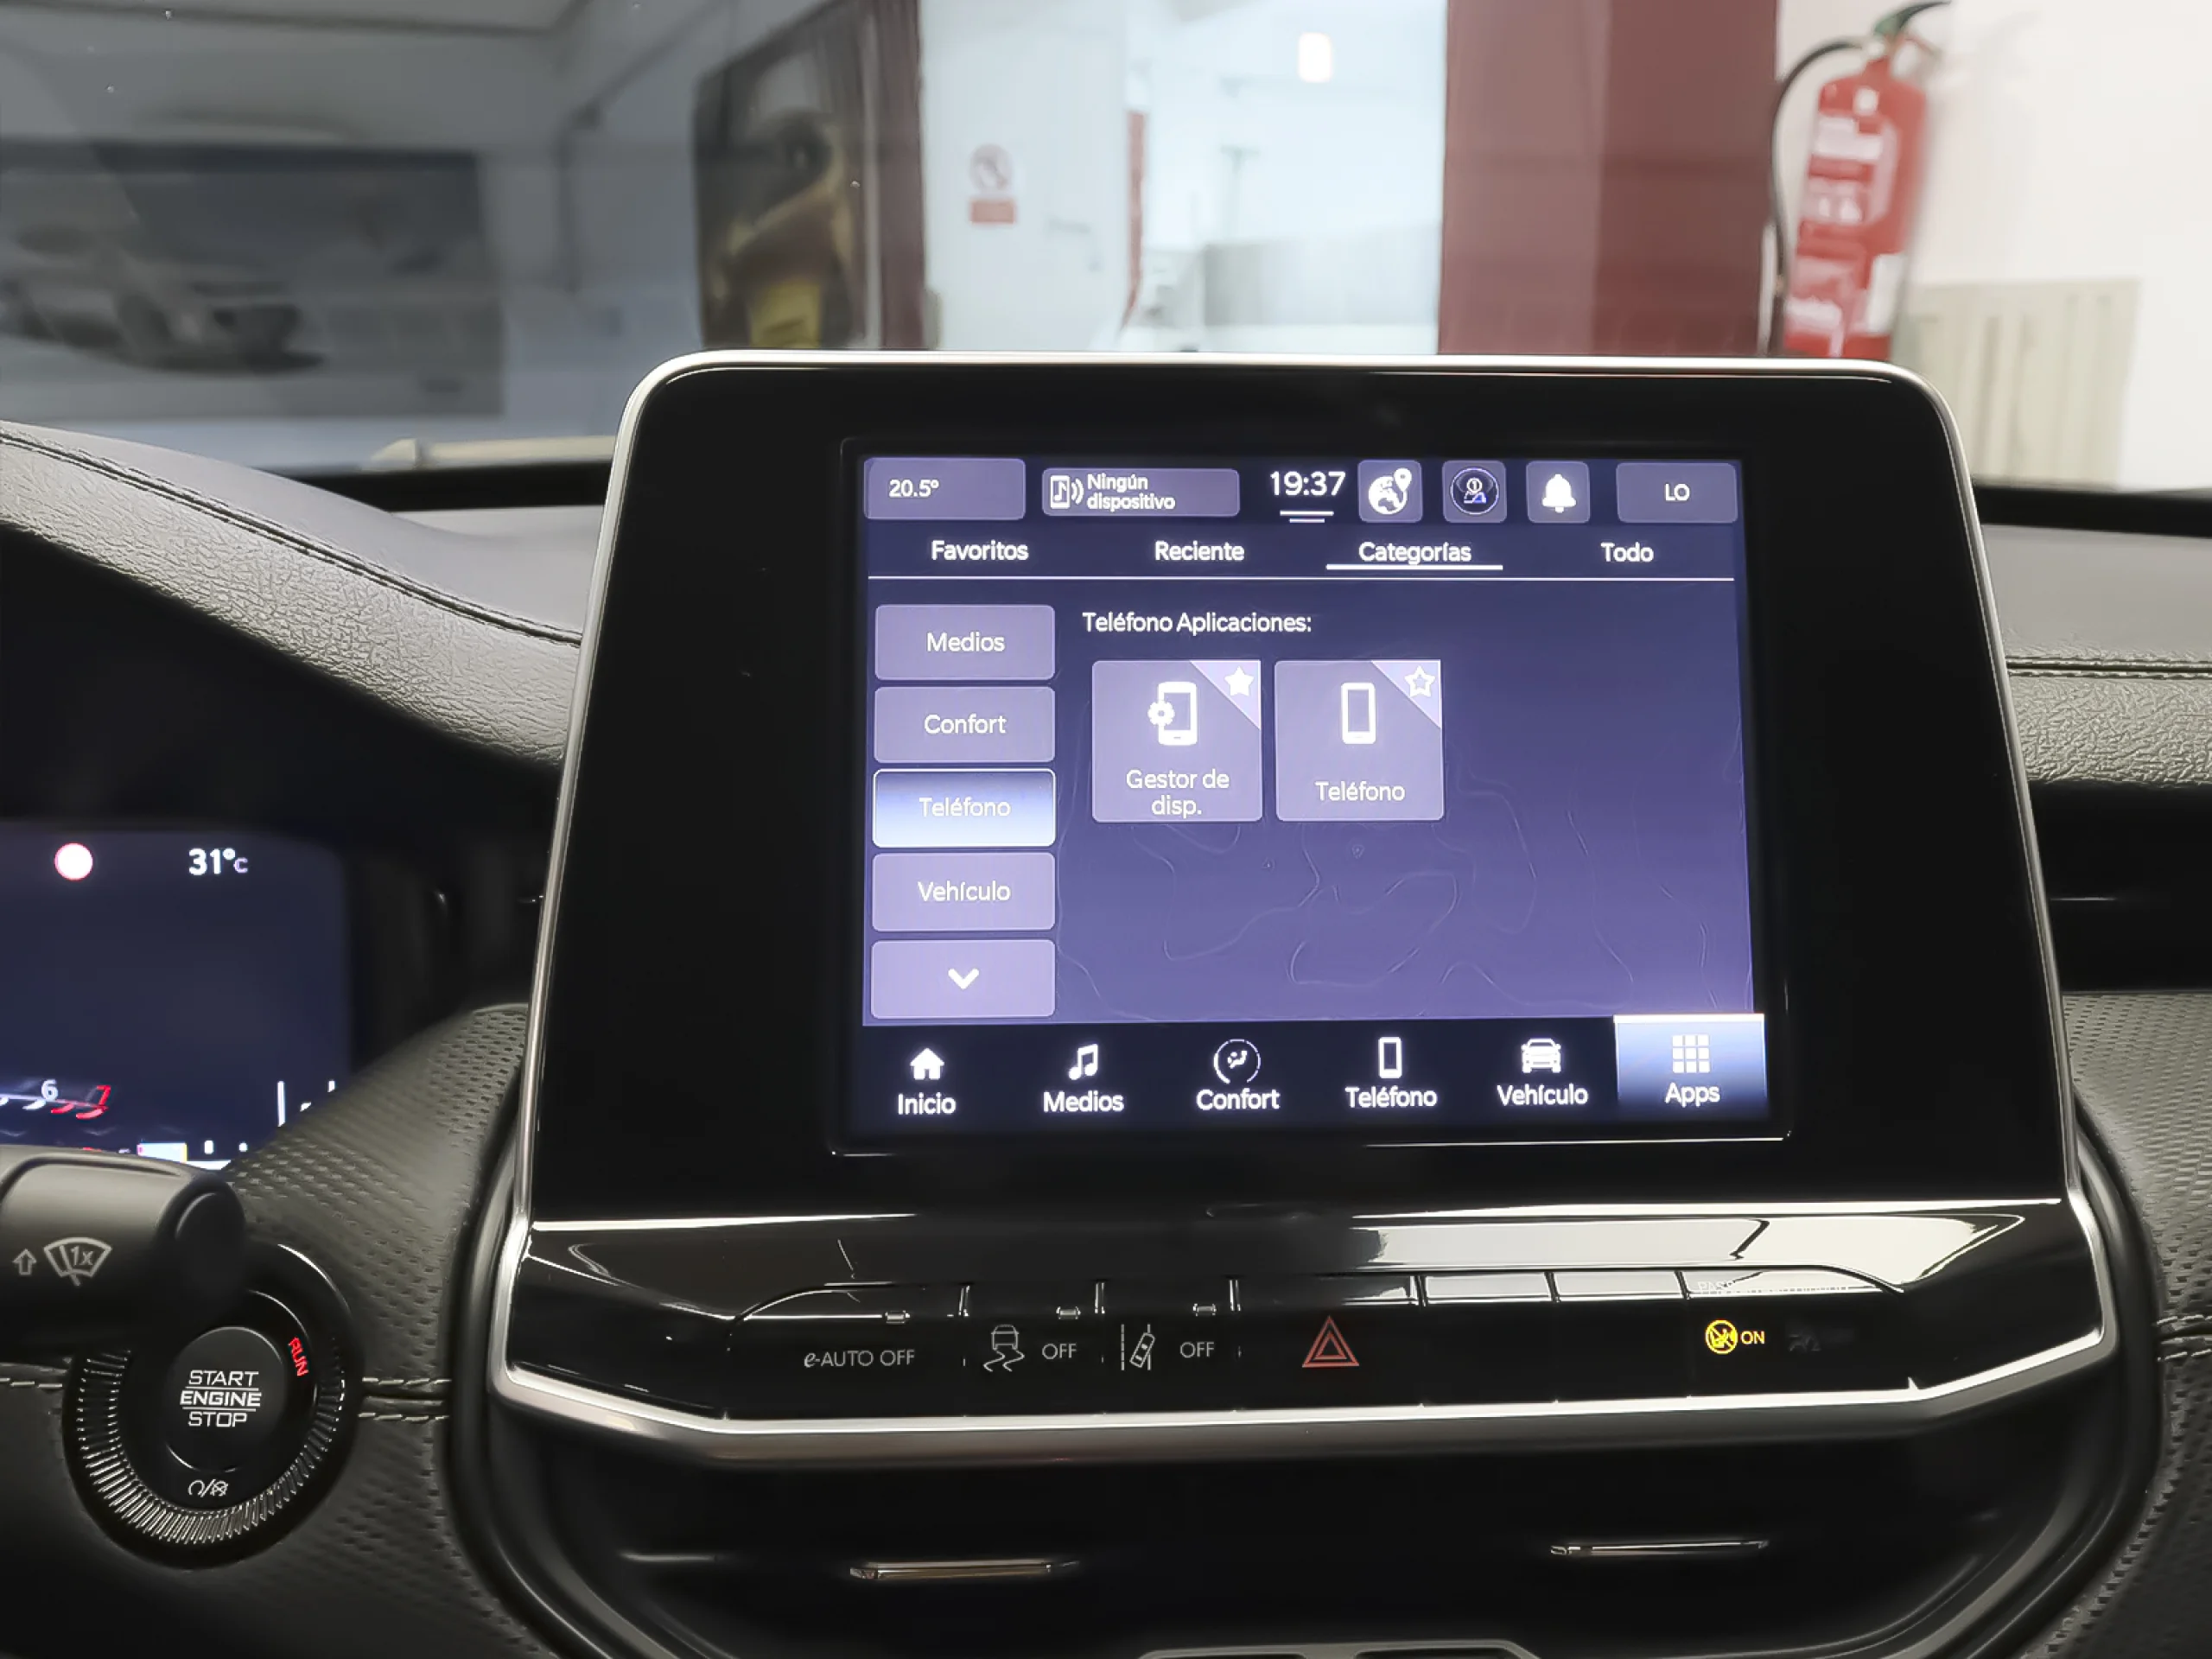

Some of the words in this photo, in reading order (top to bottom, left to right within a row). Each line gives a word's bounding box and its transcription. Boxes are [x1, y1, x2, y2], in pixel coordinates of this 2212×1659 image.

[888, 479, 939, 498] 20.5°
[1087, 474, 1148, 493] Ningún
[1270, 471, 1346, 496] 19:37
[1665, 483, 1690, 501] LO
[1086, 491, 1176, 512] dispositivo
[931, 539, 1029, 561] Favoritos
[1154, 540, 1245, 561] Reciente
[1358, 541, 1472, 564] Categorías
[1600, 541, 1655, 563] Todo
[1082, 611, 1173, 632] Teléfono
[1176, 612, 1312, 637] Aplicaciones:
[927, 631, 1006, 652] Medios
[924, 713, 1007, 734] Confort
[1126, 769, 1198, 789] Gestor
[1202, 768, 1230, 789] de
[1314, 780, 1406, 801] Teléfono
[918, 797, 1011, 817] Teléfono
[1151, 794, 1202, 819] disp.
[918, 880, 1011, 902] Vehículo
[41, 1078, 59, 1102] 6
[96, 1084, 111, 1107] 7
[1196, 1087, 1281, 1111] Confort
[1344, 1084, 1438, 1109] Teléfono
[1497, 1083, 1589, 1107] Vehículo
[1664, 1081, 1720, 1108] Apps
[898, 1091, 957, 1116] Inicio
[1043, 1090, 1125, 1113] Medios
[1739, 1331, 1765, 1344] ON
[288, 1337, 308, 1376] RUN
[804, 1350, 874, 1368] e-AUTO
[880, 1349, 915, 1367] OFF
[1041, 1343, 1077, 1360] OFF
[1179, 1342, 1215, 1358] OFF
[188, 1370, 260, 1387] START
[180, 1389, 262, 1407] ENGINE
[188, 1411, 248, 1427] STOP
